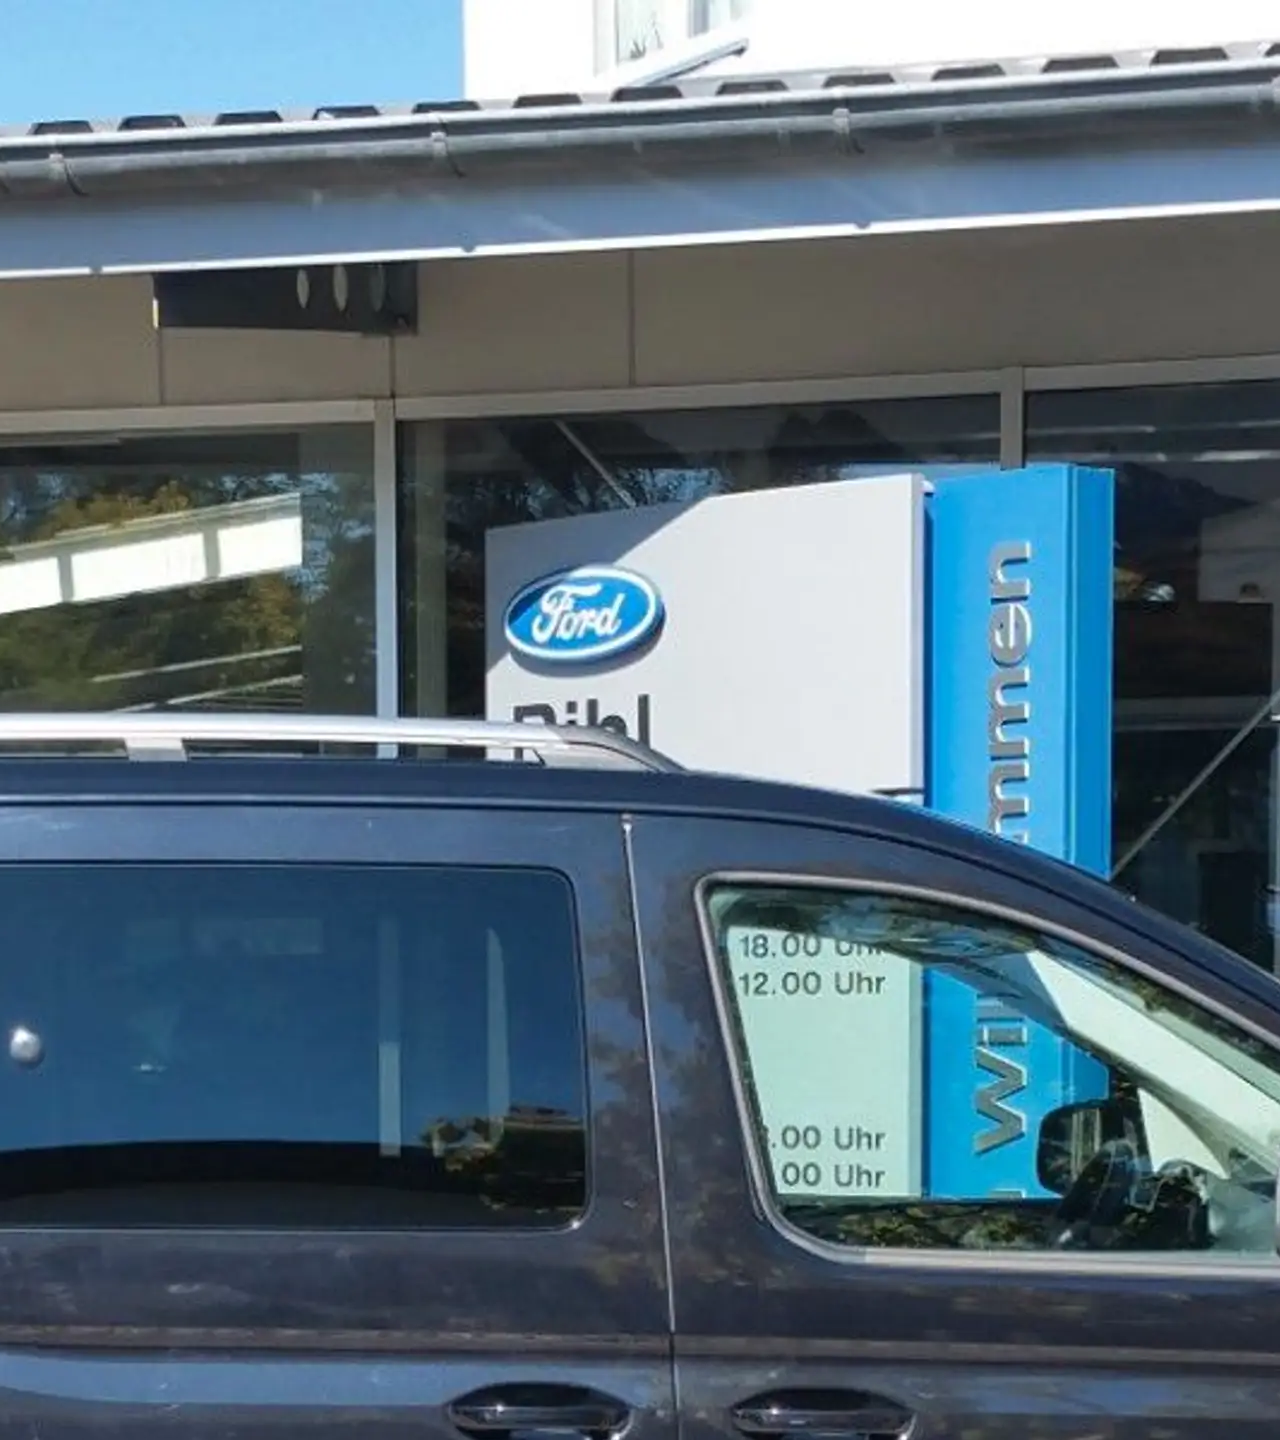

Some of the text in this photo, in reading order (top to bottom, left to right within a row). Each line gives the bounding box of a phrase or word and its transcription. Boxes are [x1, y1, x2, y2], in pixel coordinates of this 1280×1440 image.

[531, 583, 625, 644] Ford
[987, 541, 1030, 844] mmen
[738, 933, 822, 958] 18.00
[738, 971, 886, 996] 12.00 Uhr
[973, 995, 1028, 1156] Wil
[765, 1124, 886, 1150] .00 Uhr
[781, 1161, 886, 1188] 00 Uhr
